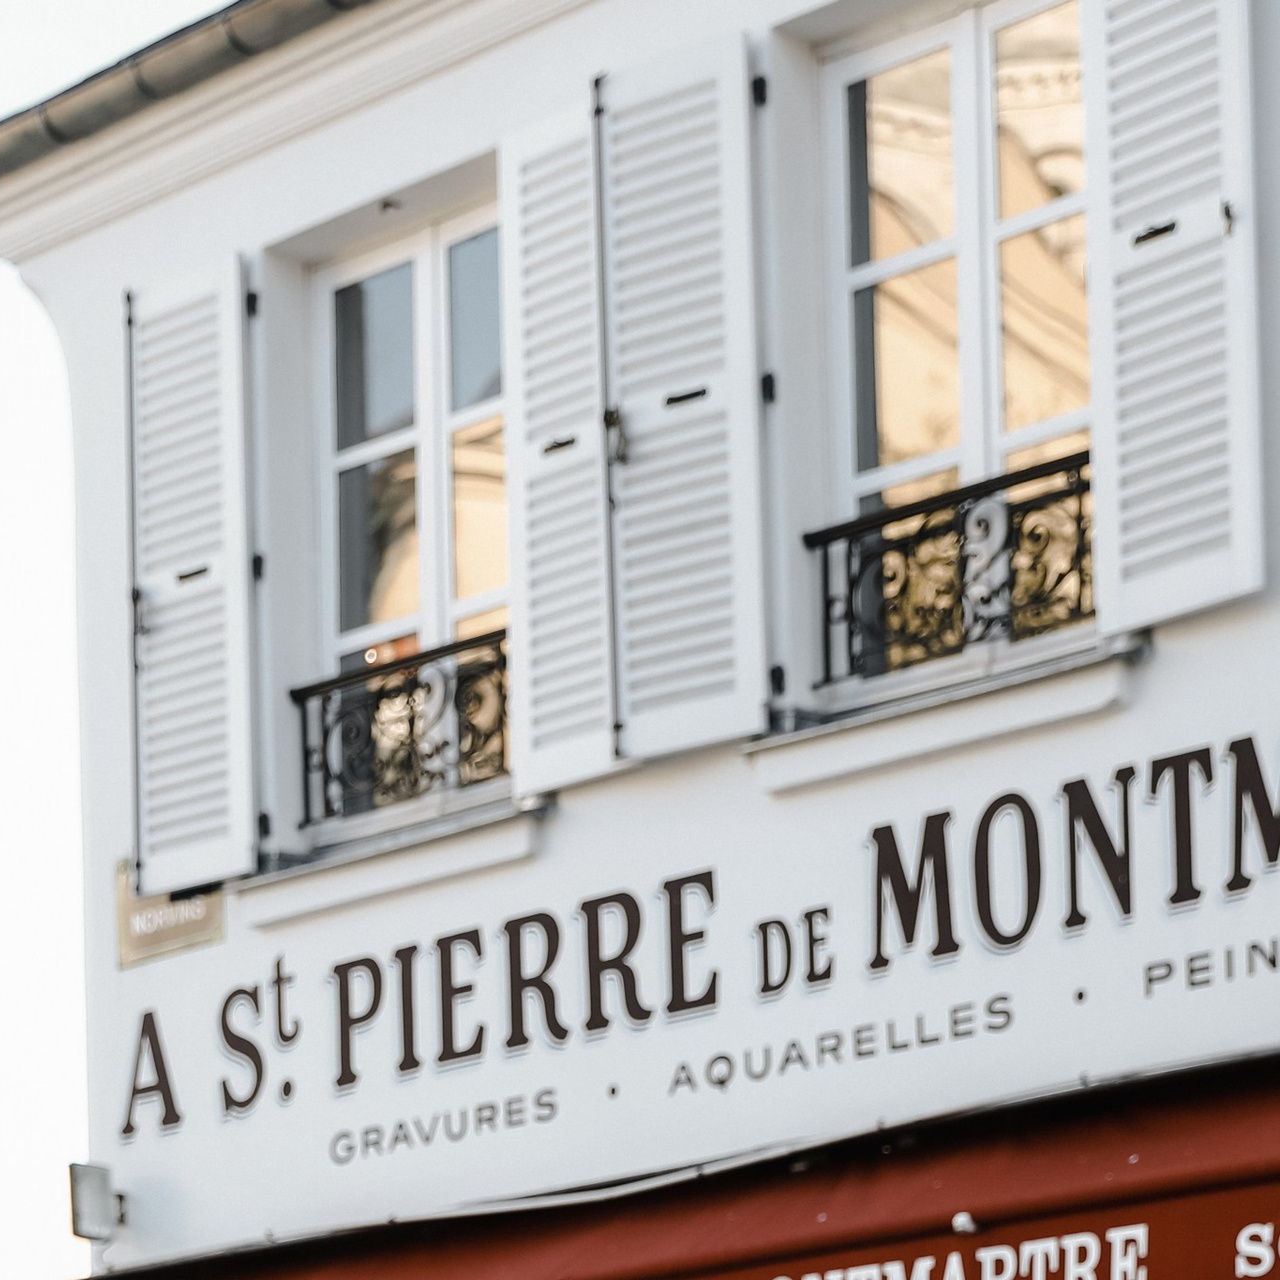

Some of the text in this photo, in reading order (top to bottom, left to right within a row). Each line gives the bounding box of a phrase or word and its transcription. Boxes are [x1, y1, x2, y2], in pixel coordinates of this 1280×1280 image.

[122, 1012, 181, 1134] A
[333, 870, 717, 1087] PIERRE
[758, 908, 833, 993] DE
[329, 939, 1280, 1165] GRAVURES AQUARELLES PEIN
